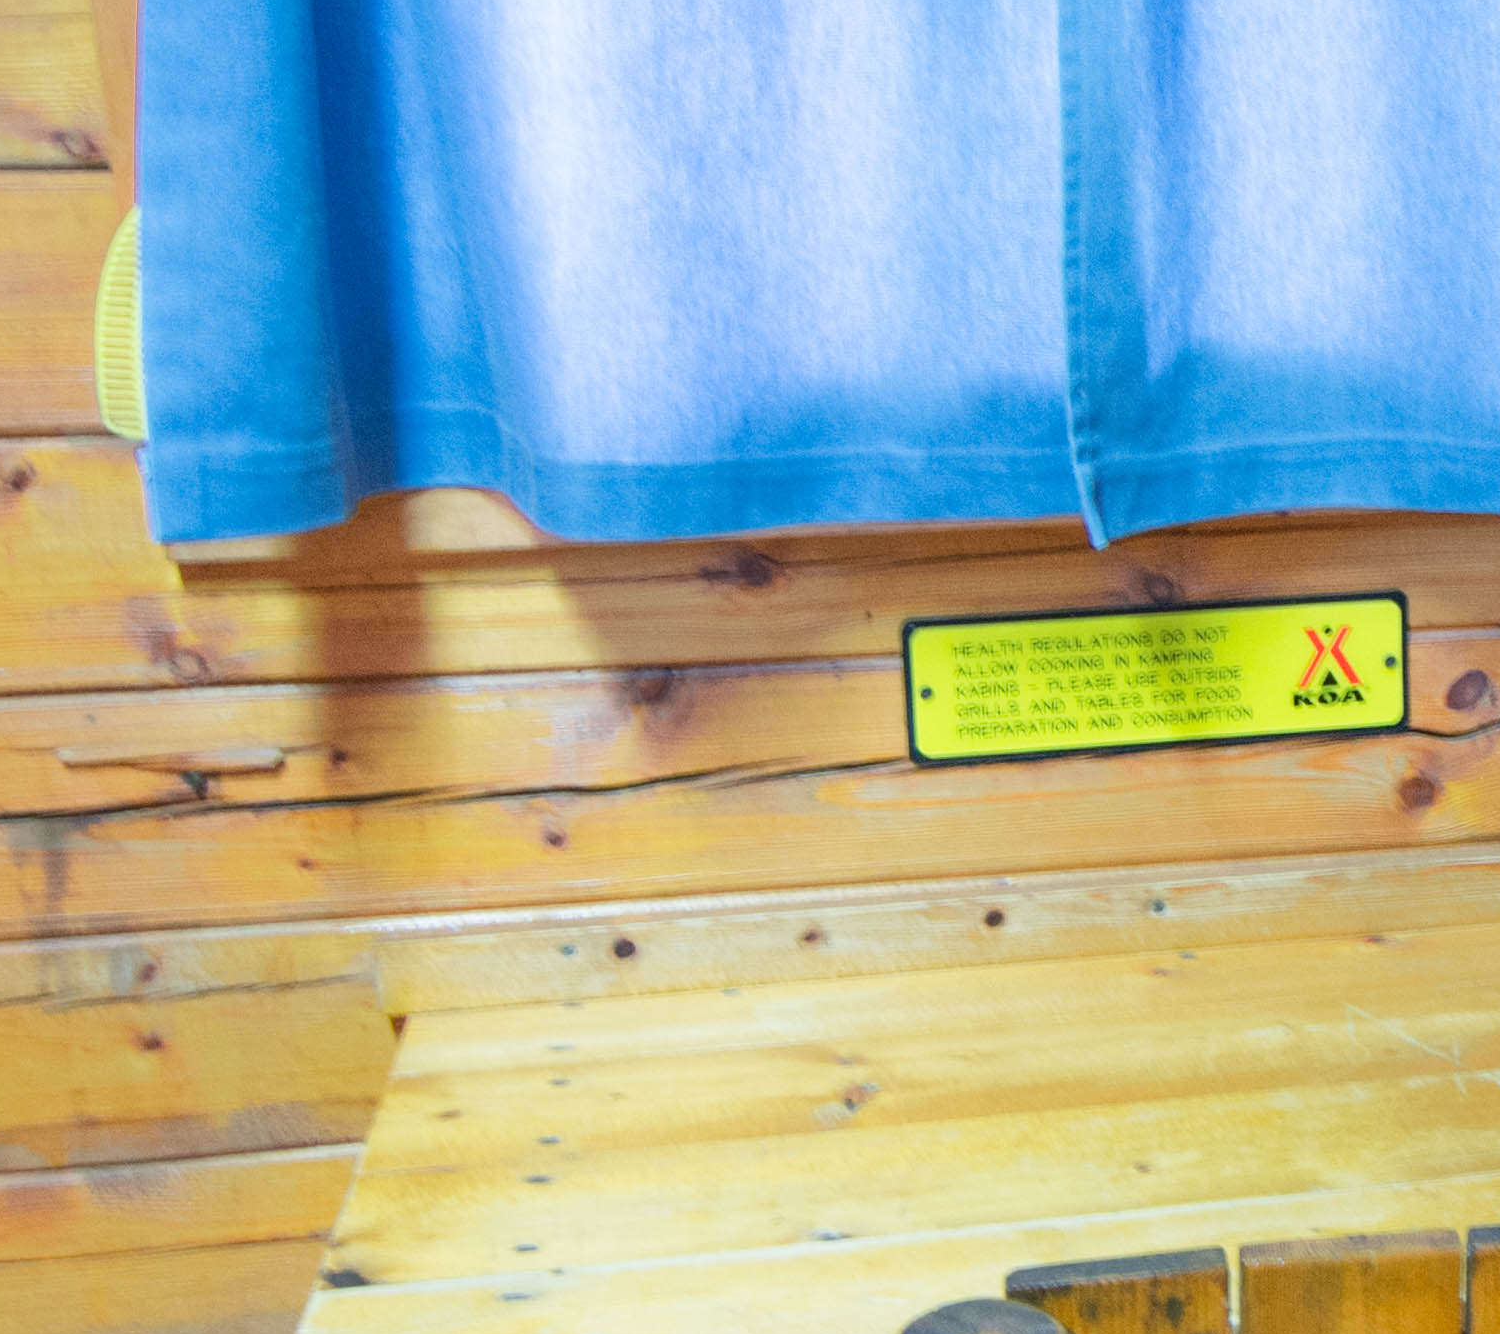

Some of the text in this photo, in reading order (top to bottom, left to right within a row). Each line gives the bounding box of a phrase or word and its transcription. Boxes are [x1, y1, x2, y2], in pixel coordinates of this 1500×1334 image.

[952, 626, 1229, 658] HEALTH REGULATIONS DO NOT
[955, 648, 1214, 678] ALLOW COOKING IN KAMPING
[957, 681, 1020, 699] KABINS
[1047, 673, 1115, 692] PLEASE
[1125, 670, 1157, 686] USE
[1169, 666, 1243, 684] OUTSIDE
[1294, 689, 1364, 707] KOA
[956, 686, 1241, 718] GRILLS AND TABLES FOR FOOD
[957, 706, 1253, 739] PREPARATION AND CONSUMPTION
